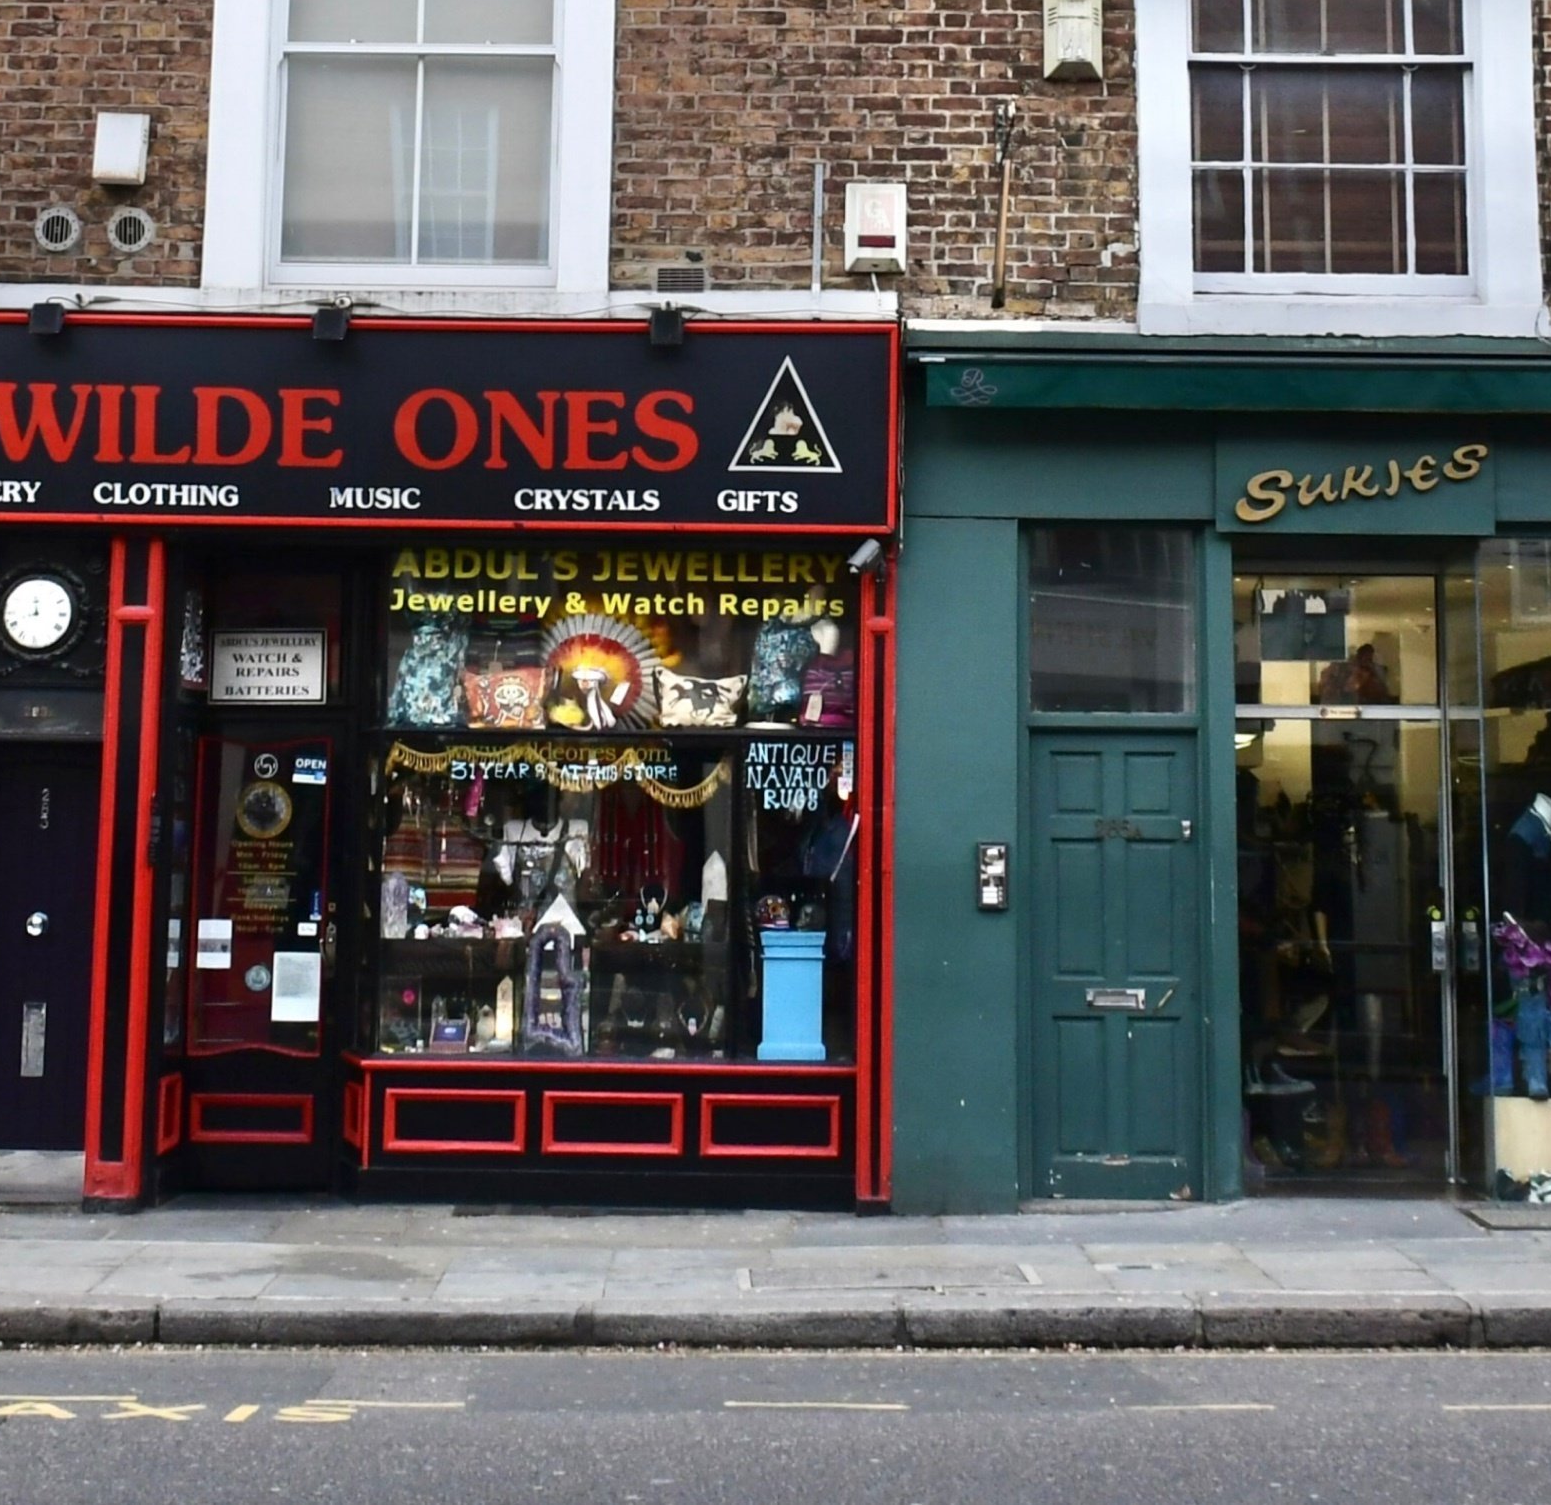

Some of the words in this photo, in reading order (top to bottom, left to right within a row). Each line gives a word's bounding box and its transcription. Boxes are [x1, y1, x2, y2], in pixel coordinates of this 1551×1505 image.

[393, 387, 700, 472] ONES
[93, 481, 240, 508] CLOTHING
[329, 486, 422, 510] MUSIC
[514, 488, 661, 512] CRYSTALS
[716, 490, 799, 514] GIFTS
[392, 548, 579, 581] ABDUL'S
[592, 550, 845, 584] JEWELLERY
[389, 588, 552, 618] Jewellery
[564, 592, 587, 615] &
[602, 592, 705, 616] Watch
[719, 593, 845, 622] Repairs
[232, 652, 287, 663] WATCH
[291, 652, 303, 663] &
[235, 666, 301, 677] REPAIRS
[224, 685, 310, 696] BATTERIES
[295, 758, 327, 770] OPEN
[745, 742, 837, 765] ANTIQUE
[451, 761, 477, 781] 31
[623, 763, 678, 782] STORE
[746, 766, 830, 790] NAVAJO
[763, 789, 819, 812] RUGS
